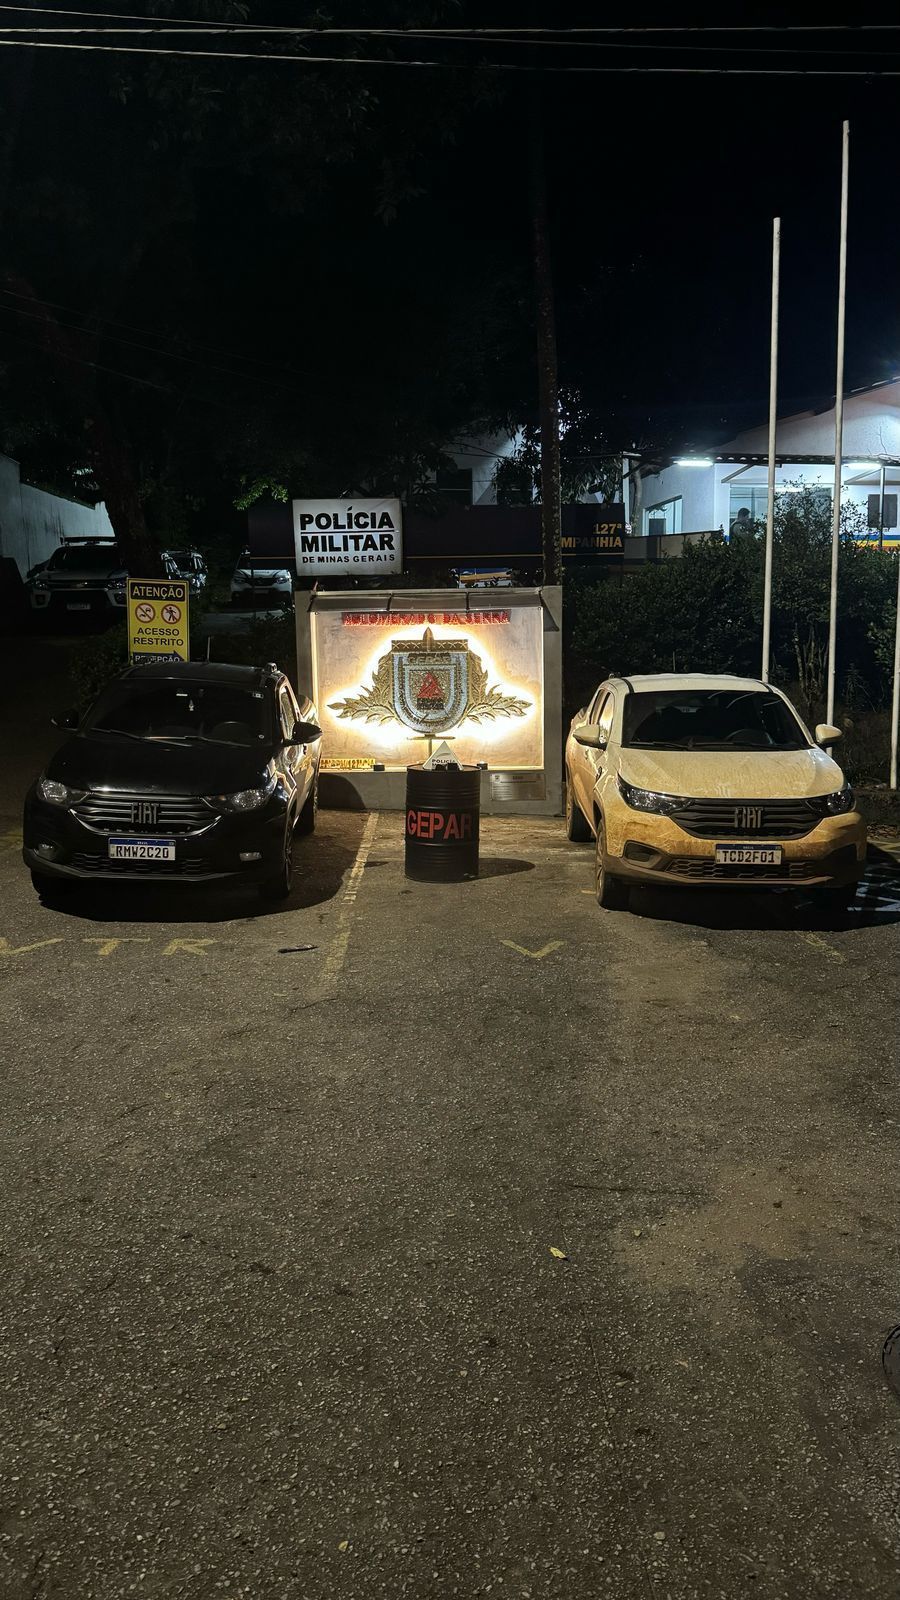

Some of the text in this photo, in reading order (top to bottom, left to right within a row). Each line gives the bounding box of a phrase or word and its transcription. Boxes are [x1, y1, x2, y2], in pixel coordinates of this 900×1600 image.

[300, 506, 395, 530] POLÍCIA
[301, 534, 395, 552] MILITAR
[561, 536, 623, 548] MPANHIA
[353, 554, 395, 563] GERAIS
[132, 585, 184, 599] ATENÇÃO
[137, 627, 180, 636] ACESSO
[133, 637, 184, 646] RESTRITO
[131, 802, 159, 824] FIAT
[735, 807, 763, 828] FIAT
[407, 809, 473, 839] GEPAR
[116, 846, 169, 858] RMW2C20
[722, 851, 775, 863] TCD2F01
